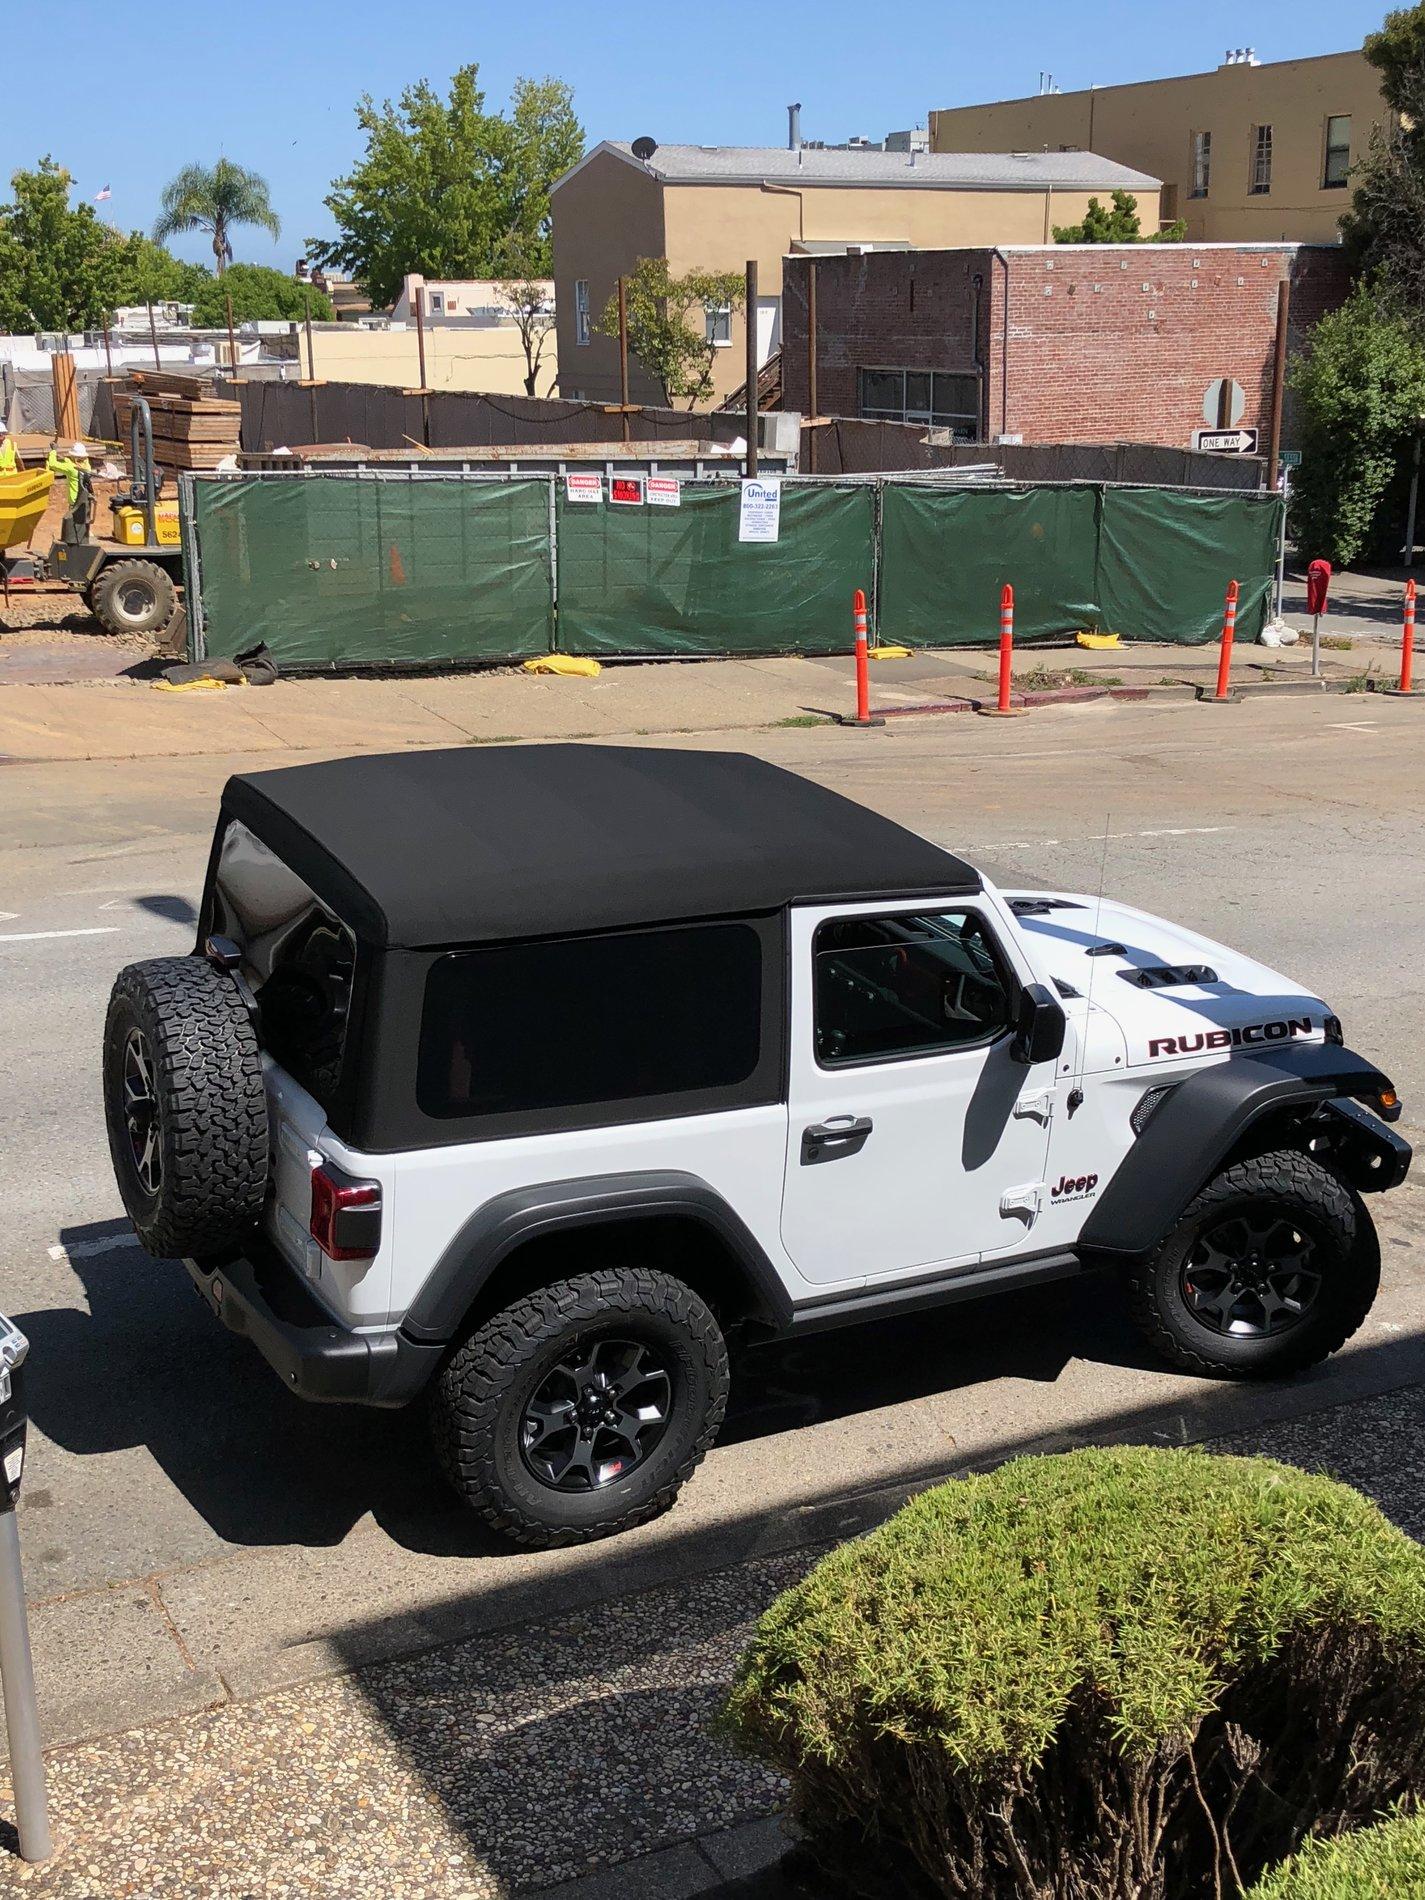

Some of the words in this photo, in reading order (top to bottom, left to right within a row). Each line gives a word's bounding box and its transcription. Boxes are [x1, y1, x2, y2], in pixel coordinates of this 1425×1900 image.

[1203, 438, 1220, 448] ONE
[1223, 437, 1240, 447] WAY
[616, 480, 625, 490] NO
[747, 489, 778, 498] United
[1148, 1017, 1312, 1057] RUBICON
[1051, 1173, 1098, 1197] Jeep
[1050, 1192, 1096, 1205] WRANGLER
